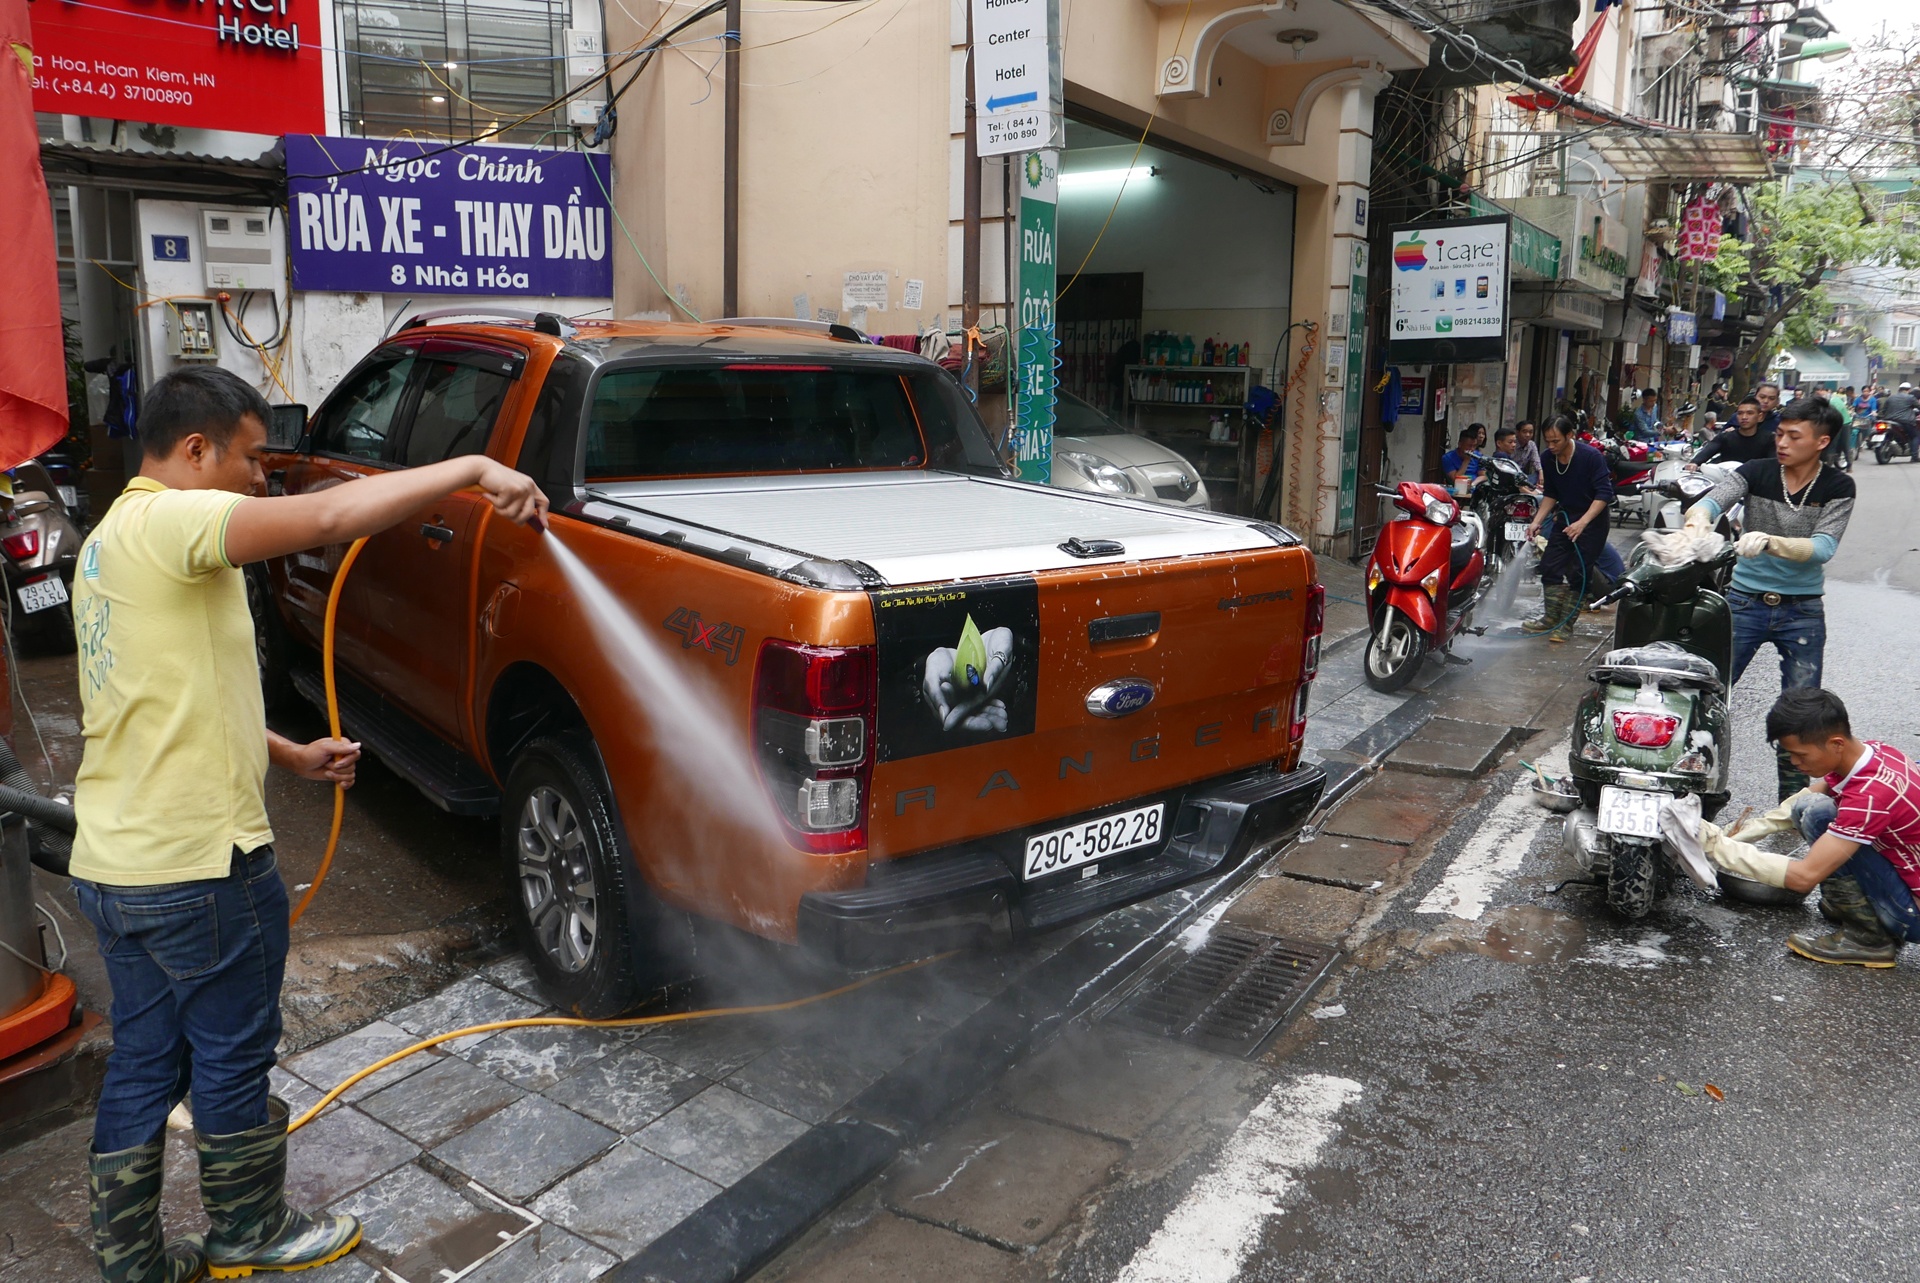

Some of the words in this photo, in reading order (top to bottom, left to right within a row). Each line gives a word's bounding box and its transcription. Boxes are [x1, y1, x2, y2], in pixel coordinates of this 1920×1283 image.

[218, 14, 299, 50] Hotel
[988, 28, 1031, 46] Center
[51, 54, 91, 74] Hoa,
[94, 60, 138, 79] Hoan
[146, 66, 189, 86] Kiem,
[193, 73, 215, 88] HN
[995, 64, 1026, 82] Hotel
[31, 75, 49, 90] el:
[52, 77, 116, 99] (+84.4)
[123, 84, 193, 106] 37100890
[987, 121, 1004, 132] Tel:
[989, 134, 1000, 144] 37
[1003, 131, 1019, 142] 100
[1020, 128, 1038, 139] 890
[362, 146, 442, 184] Ngọc
[457, 153, 545, 185] Chính
[1044, 162, 1055, 183] bp
[298, 176, 372, 253] RỬA
[378, 196, 424, 255] XE
[455, 200, 533, 259] THAY
[543, 186, 607, 262] DẦU
[164, 239, 177, 257] 8
[1024, 217, 1052, 265] RỬA
[390, 264, 407, 286] 8
[415, 264, 469, 288] Nhà
[476, 264, 530, 290] Hỏa
[1454, 317, 1501, 326] 0982143839
[1027, 364, 1045, 396] XE
[1019, 420, 1049, 462] MÁY
[24, 581, 57, 599] 29-C1
[25, 591, 64, 611] 432.54
[1115, 691, 1145, 710] Ford
[895, 708, 1278, 817] RANGER
[1605, 809, 1664, 835] 135.6
[1028, 808, 1161, 876] 29C-582.28
